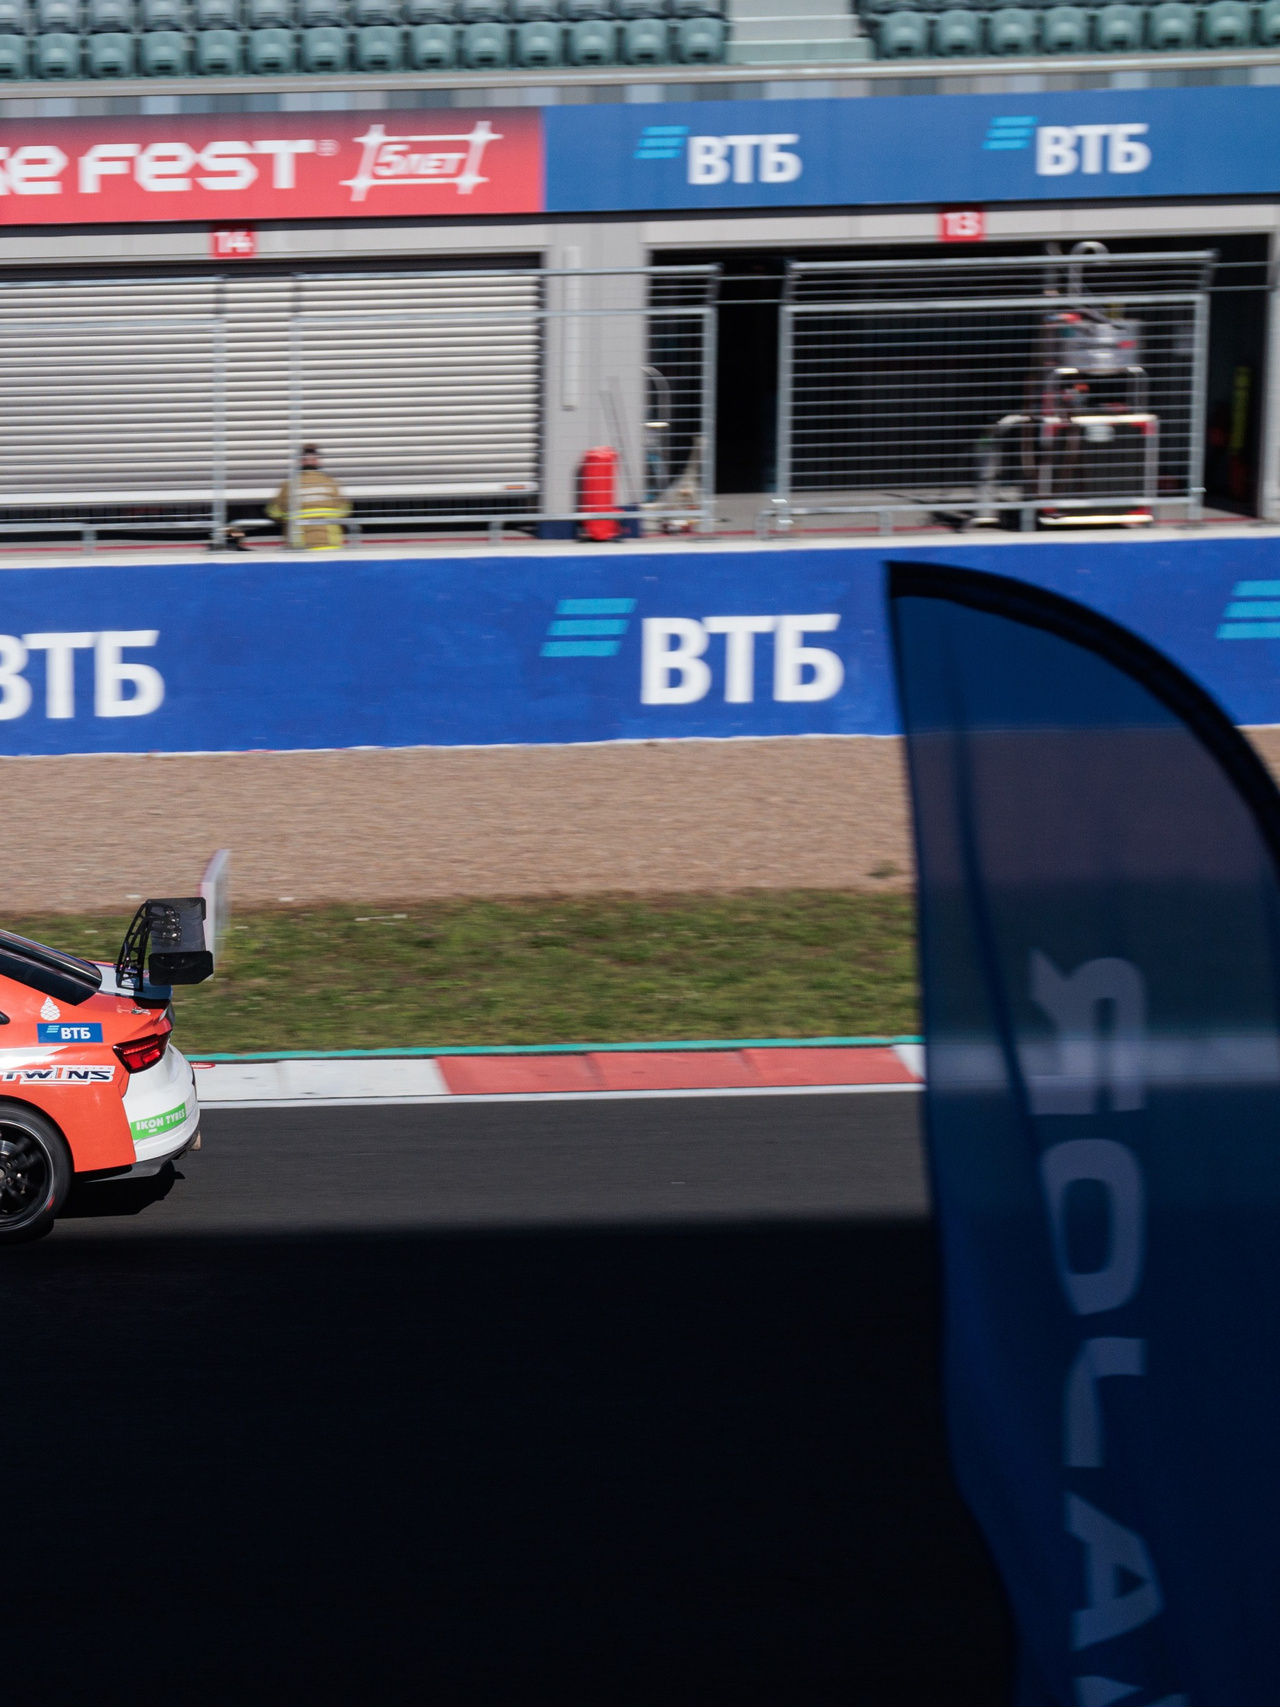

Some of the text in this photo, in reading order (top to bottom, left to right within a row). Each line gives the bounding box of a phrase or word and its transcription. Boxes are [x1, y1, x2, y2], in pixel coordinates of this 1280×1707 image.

[686, 133, 803, 185] ВТБ
[1036, 123, 1152, 176] ВТБ
[943, 211, 981, 236] 13
[214, 230, 254, 254] 14
[641, 613, 845, 704] ВТБ
[60, 1027, 91, 1040] ВТБ
[3, 1067, 113, 1081] TWINS
[136, 1108, 186, 1132] IKON TYRES
